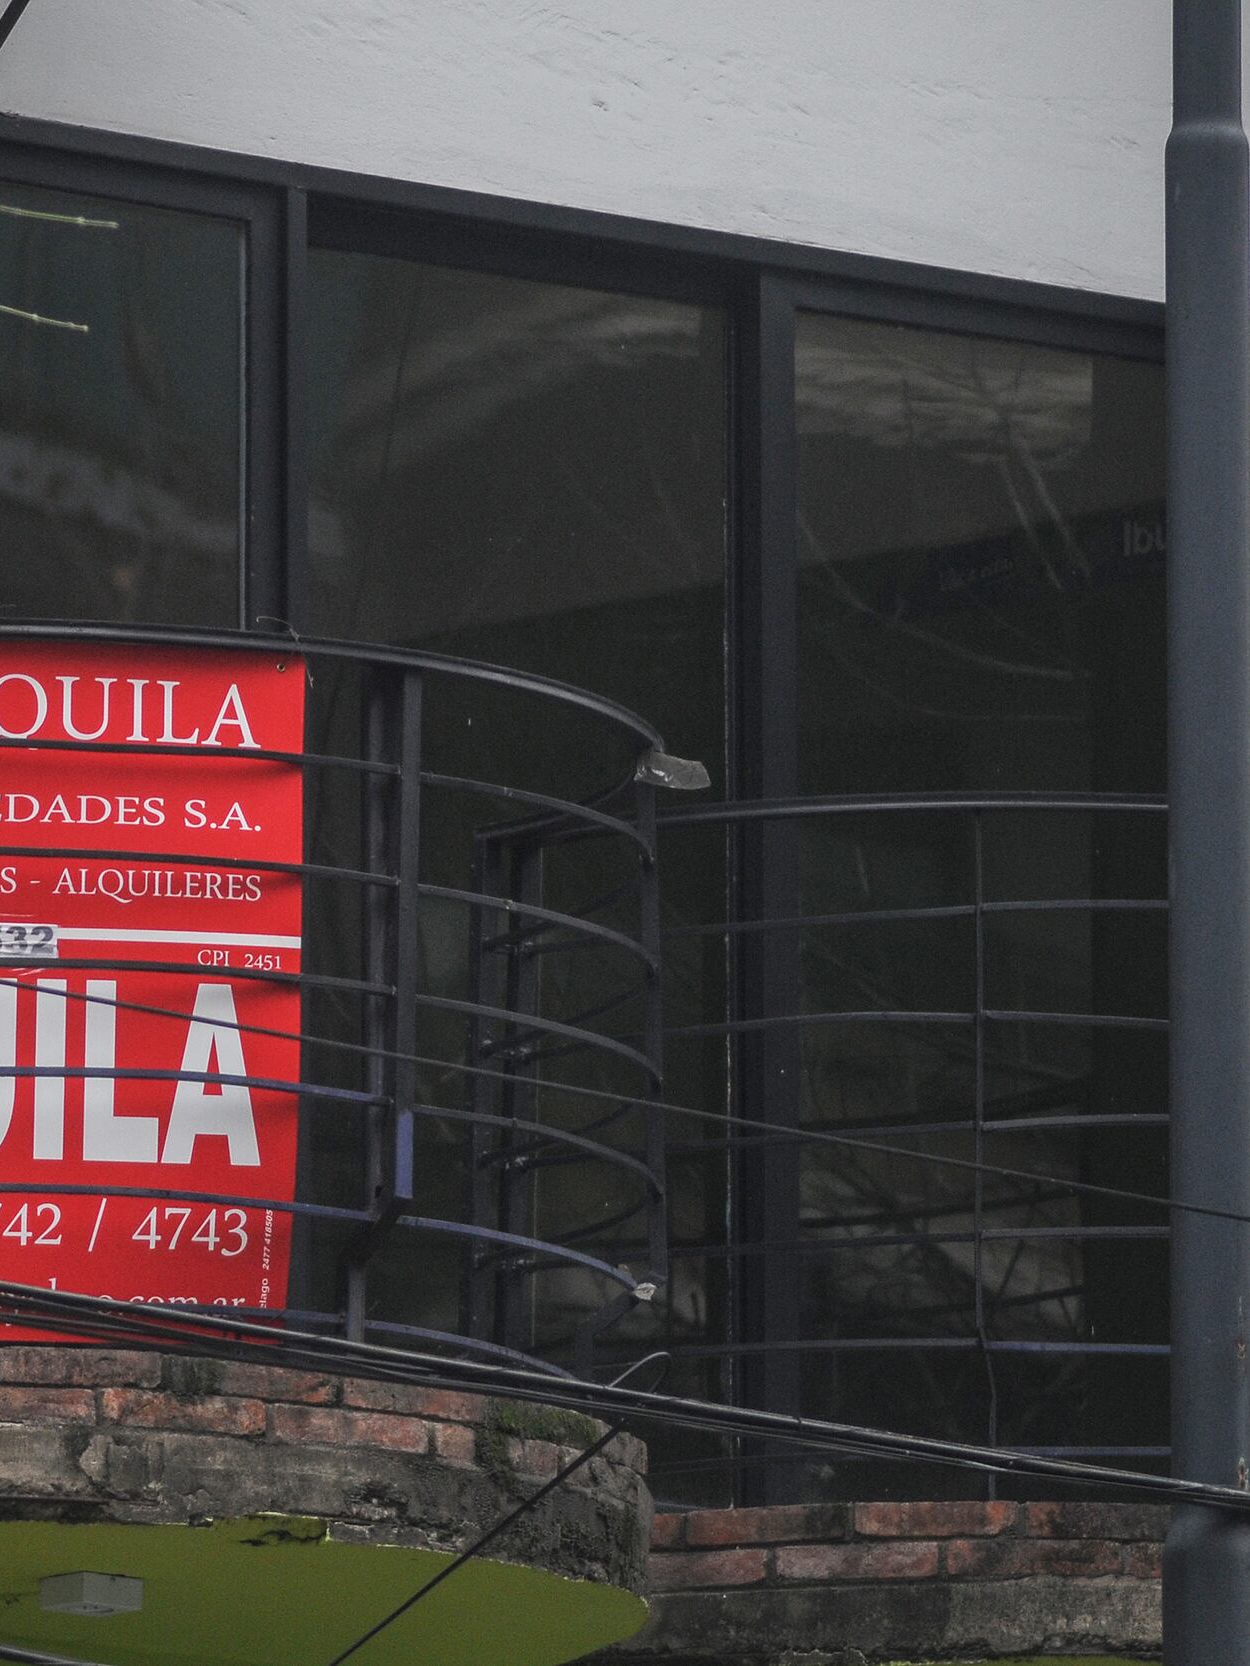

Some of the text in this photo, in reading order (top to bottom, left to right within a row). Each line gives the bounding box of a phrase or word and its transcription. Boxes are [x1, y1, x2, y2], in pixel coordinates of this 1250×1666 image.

[184, 799, 263, 832] S.A.
[52, 866, 262, 904] ALQUILERES
[197, 949, 282, 971] CPI 2451
[131, 1206, 249, 1257] 4743
